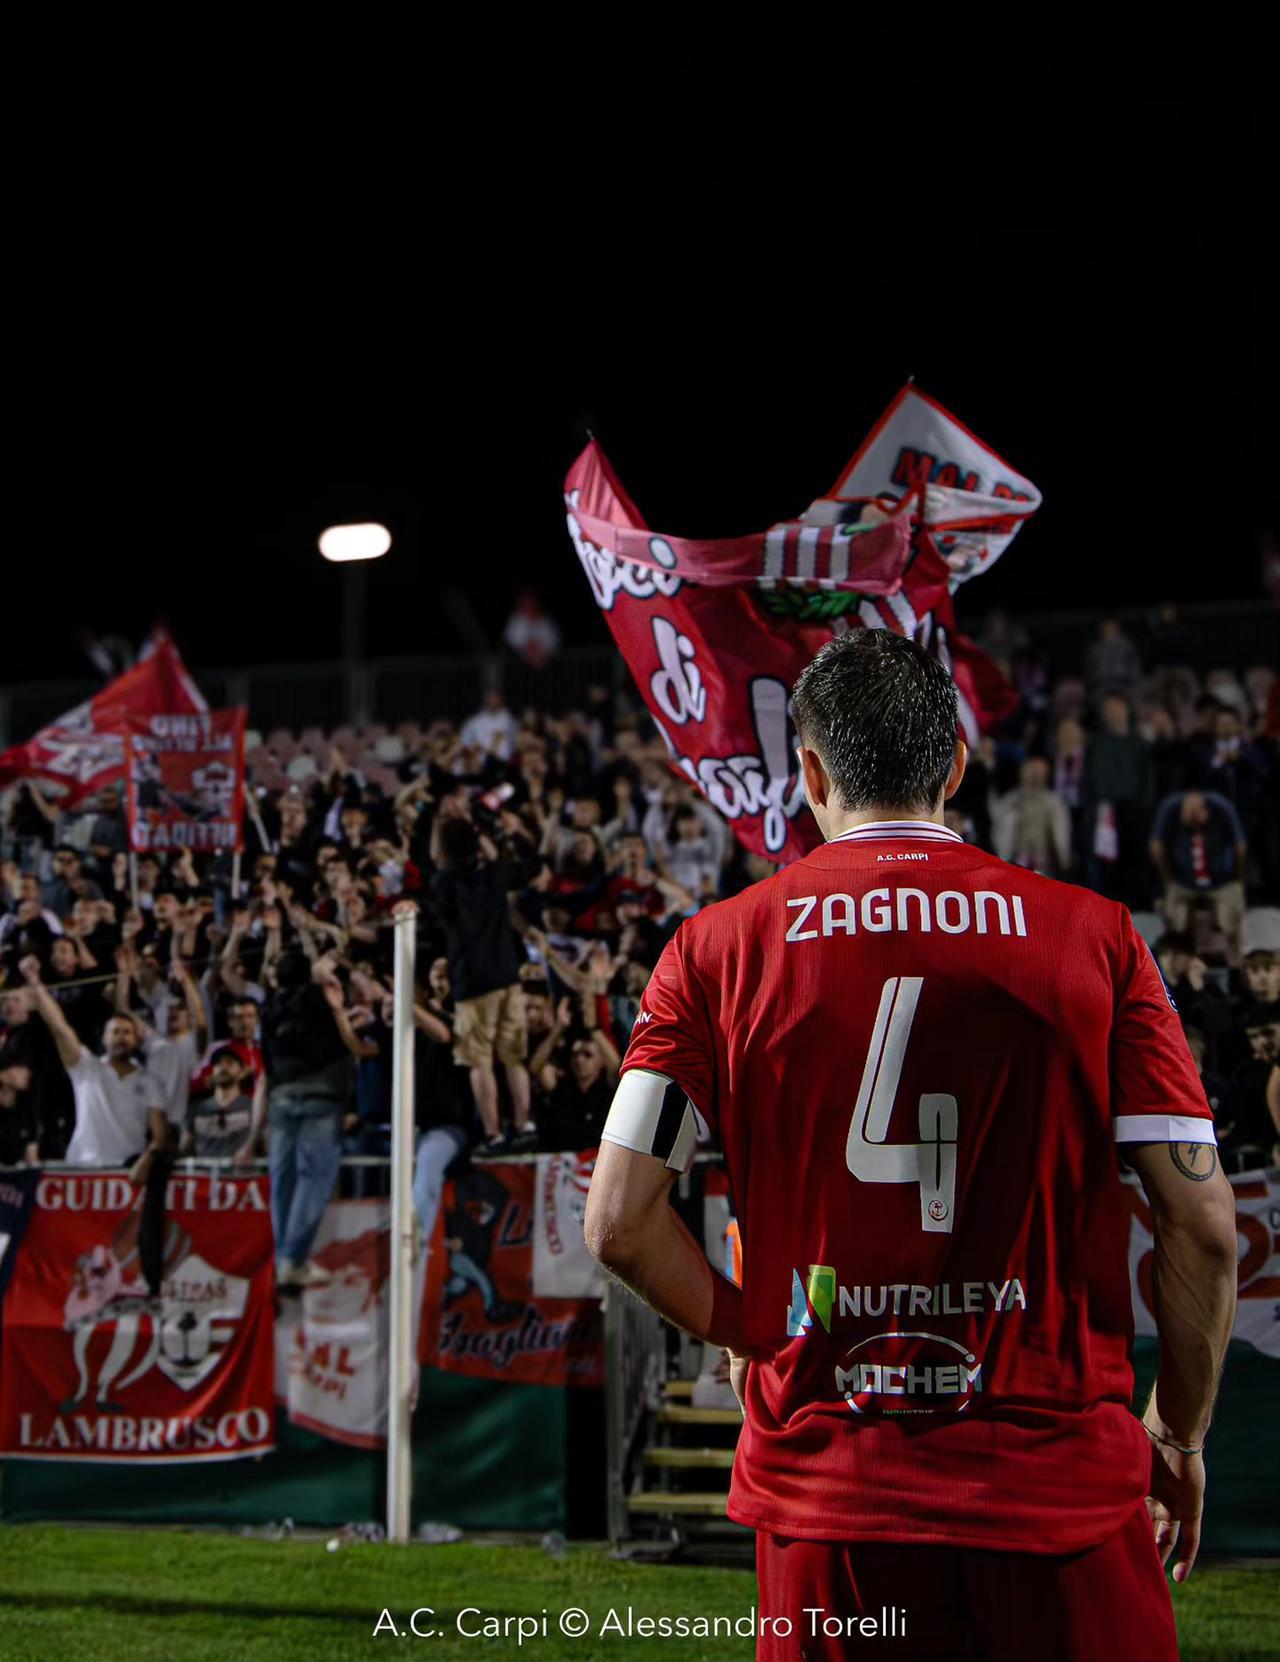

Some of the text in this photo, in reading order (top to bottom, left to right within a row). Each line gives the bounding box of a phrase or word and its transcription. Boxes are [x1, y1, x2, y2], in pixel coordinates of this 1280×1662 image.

[650, 616, 707, 724] di
[876, 853, 929, 862] A.C. CARPI
[785, 887, 1027, 942] ZAGNONI
[846, 976, 958, 1233] 4
[838, 1279, 1027, 1317] NUTRILEYA
[834, 1363, 982, 1395] MOCHEM
[20, 1407, 269, 1450] LAMBRUSCO
